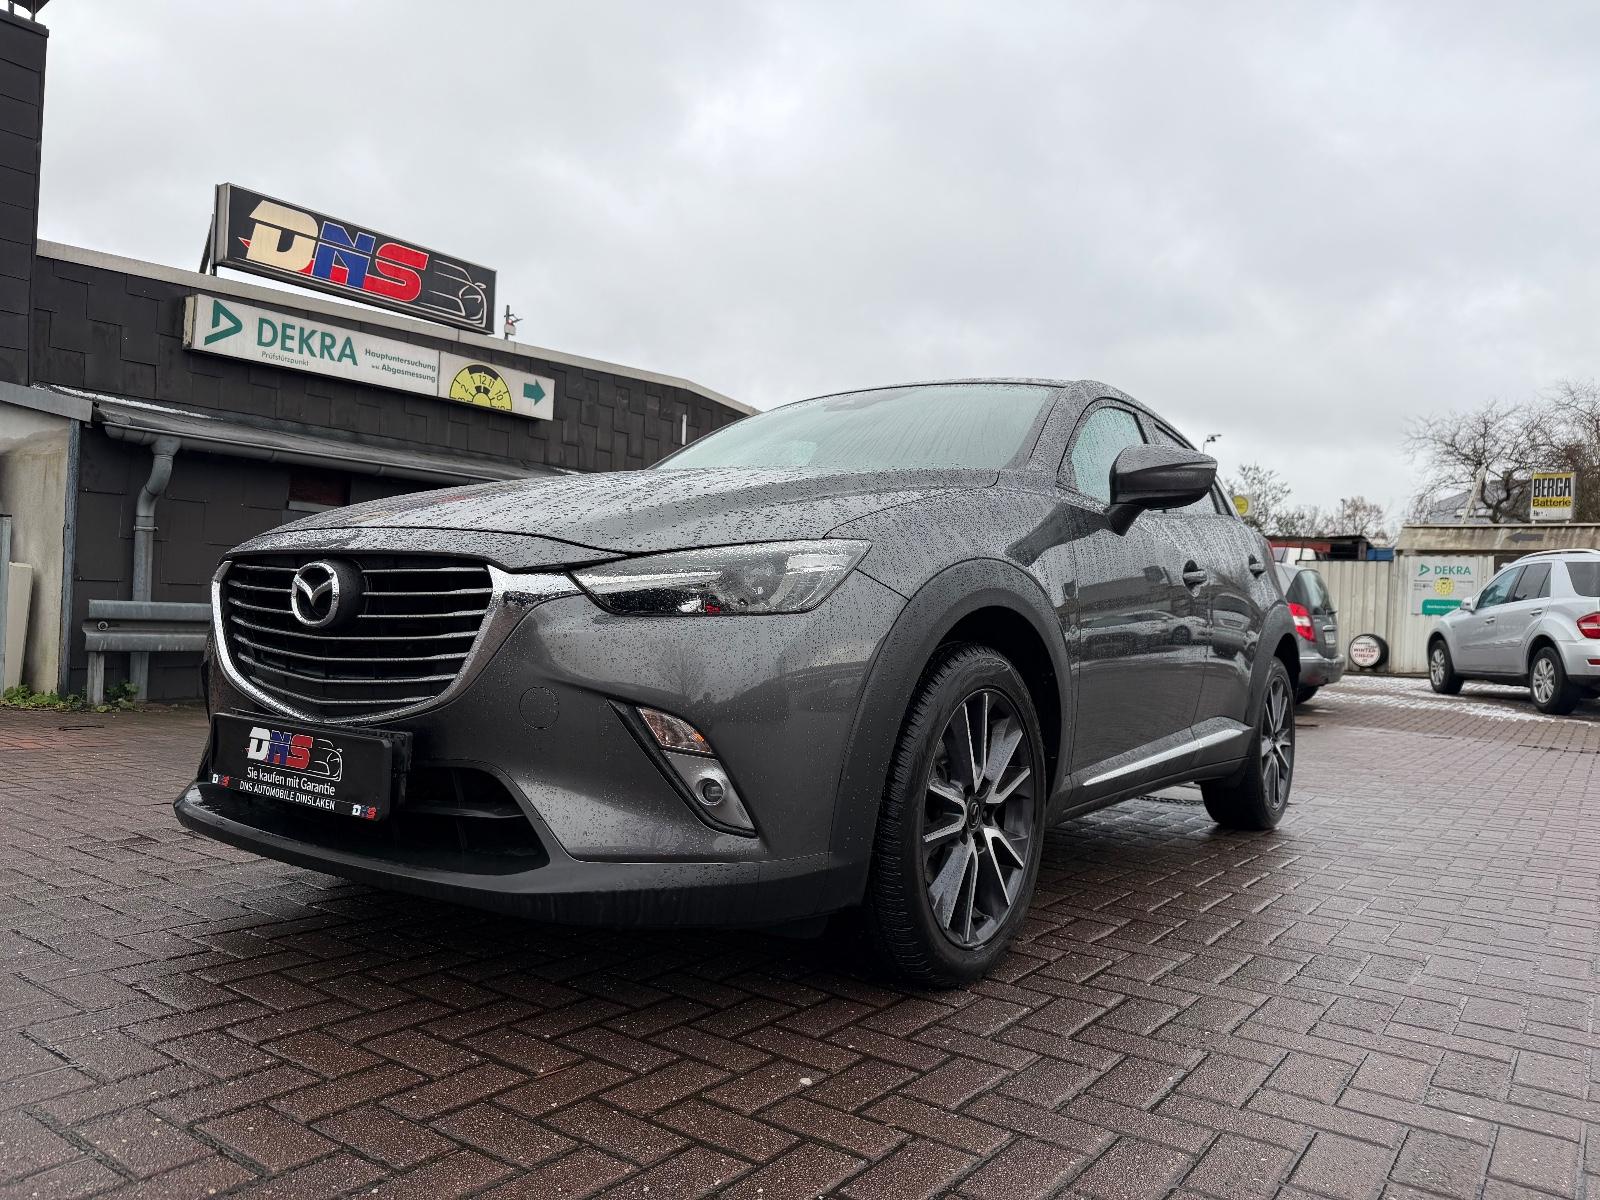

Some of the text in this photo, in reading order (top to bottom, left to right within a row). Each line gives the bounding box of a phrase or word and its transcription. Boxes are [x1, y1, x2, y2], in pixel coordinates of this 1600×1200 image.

[246, 199, 429, 302] DNS
[255, 317, 358, 366] DEKRA
[261, 351, 309, 366] Prüfstützpunkt
[365, 348, 436, 372] Hauptuntersuchung
[381, 364, 436, 383] Abgasmessung
[478, 374, 487, 386] 12
[1533, 478, 1571, 498] BERGA
[1532, 498, 1571, 508] Batterie
[1434, 565, 1472, 576] DEKRA
[247, 726, 313, 770] DNS
[247, 766, 336, 796] Sie kaufen mit Garantie
[239, 780, 336, 811] DNS AUTOMOBILE DINSLAKEN
